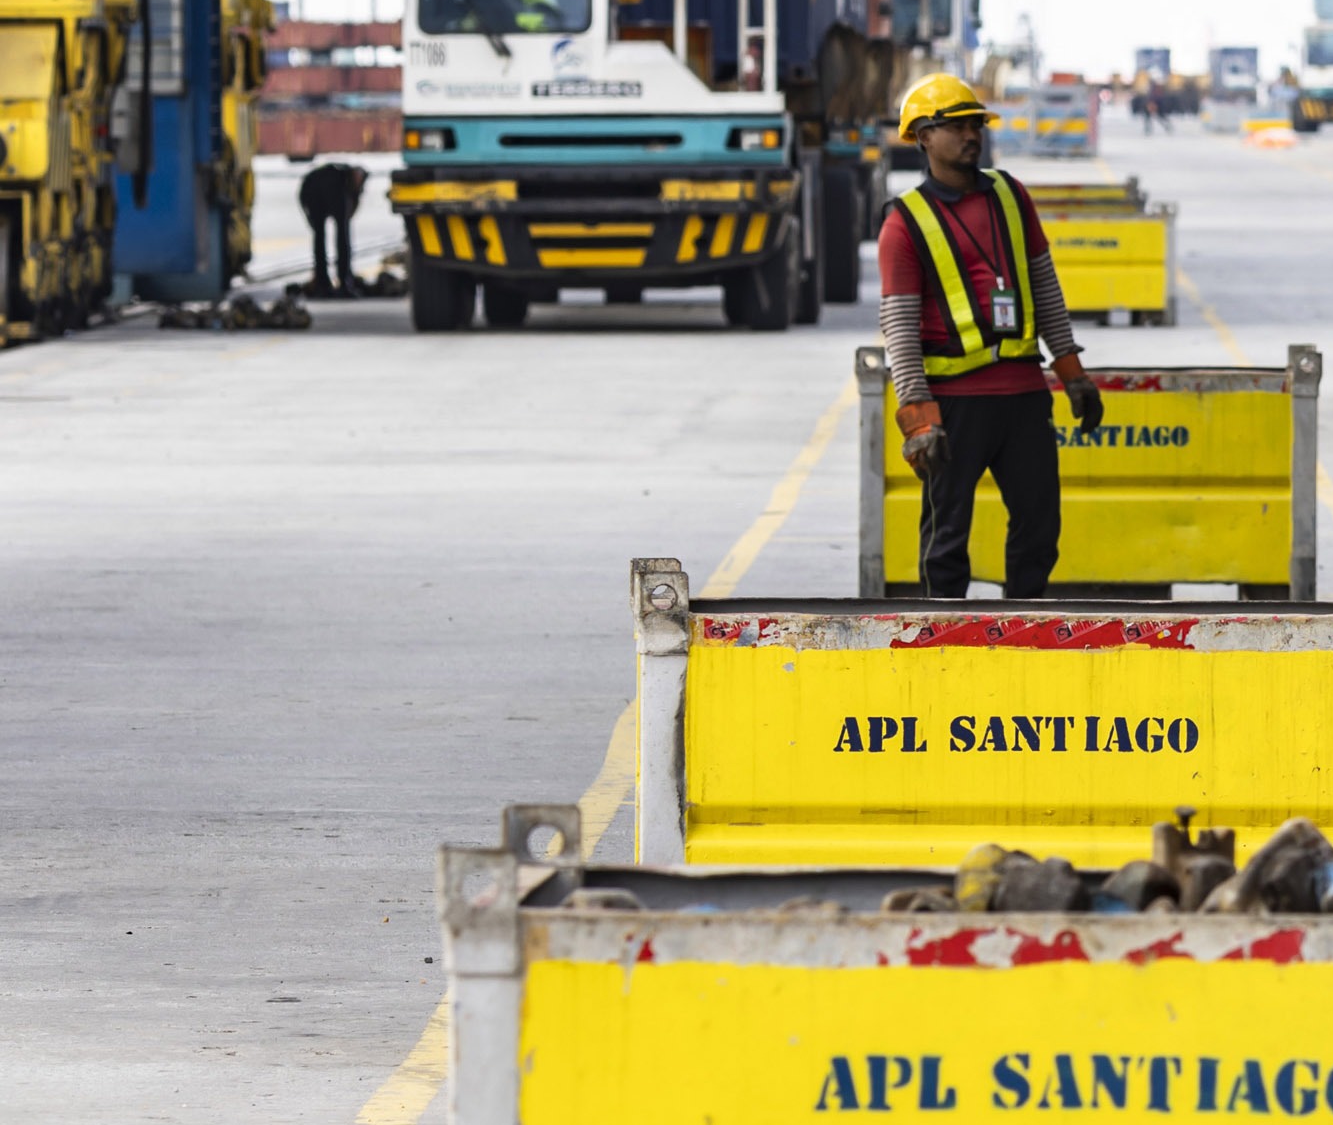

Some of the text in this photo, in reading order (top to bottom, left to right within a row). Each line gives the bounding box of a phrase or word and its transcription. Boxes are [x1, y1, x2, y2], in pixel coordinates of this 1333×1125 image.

[833, 716, 1199, 754] APL SANTIAGO
[816, 1051, 957, 1112] APL
